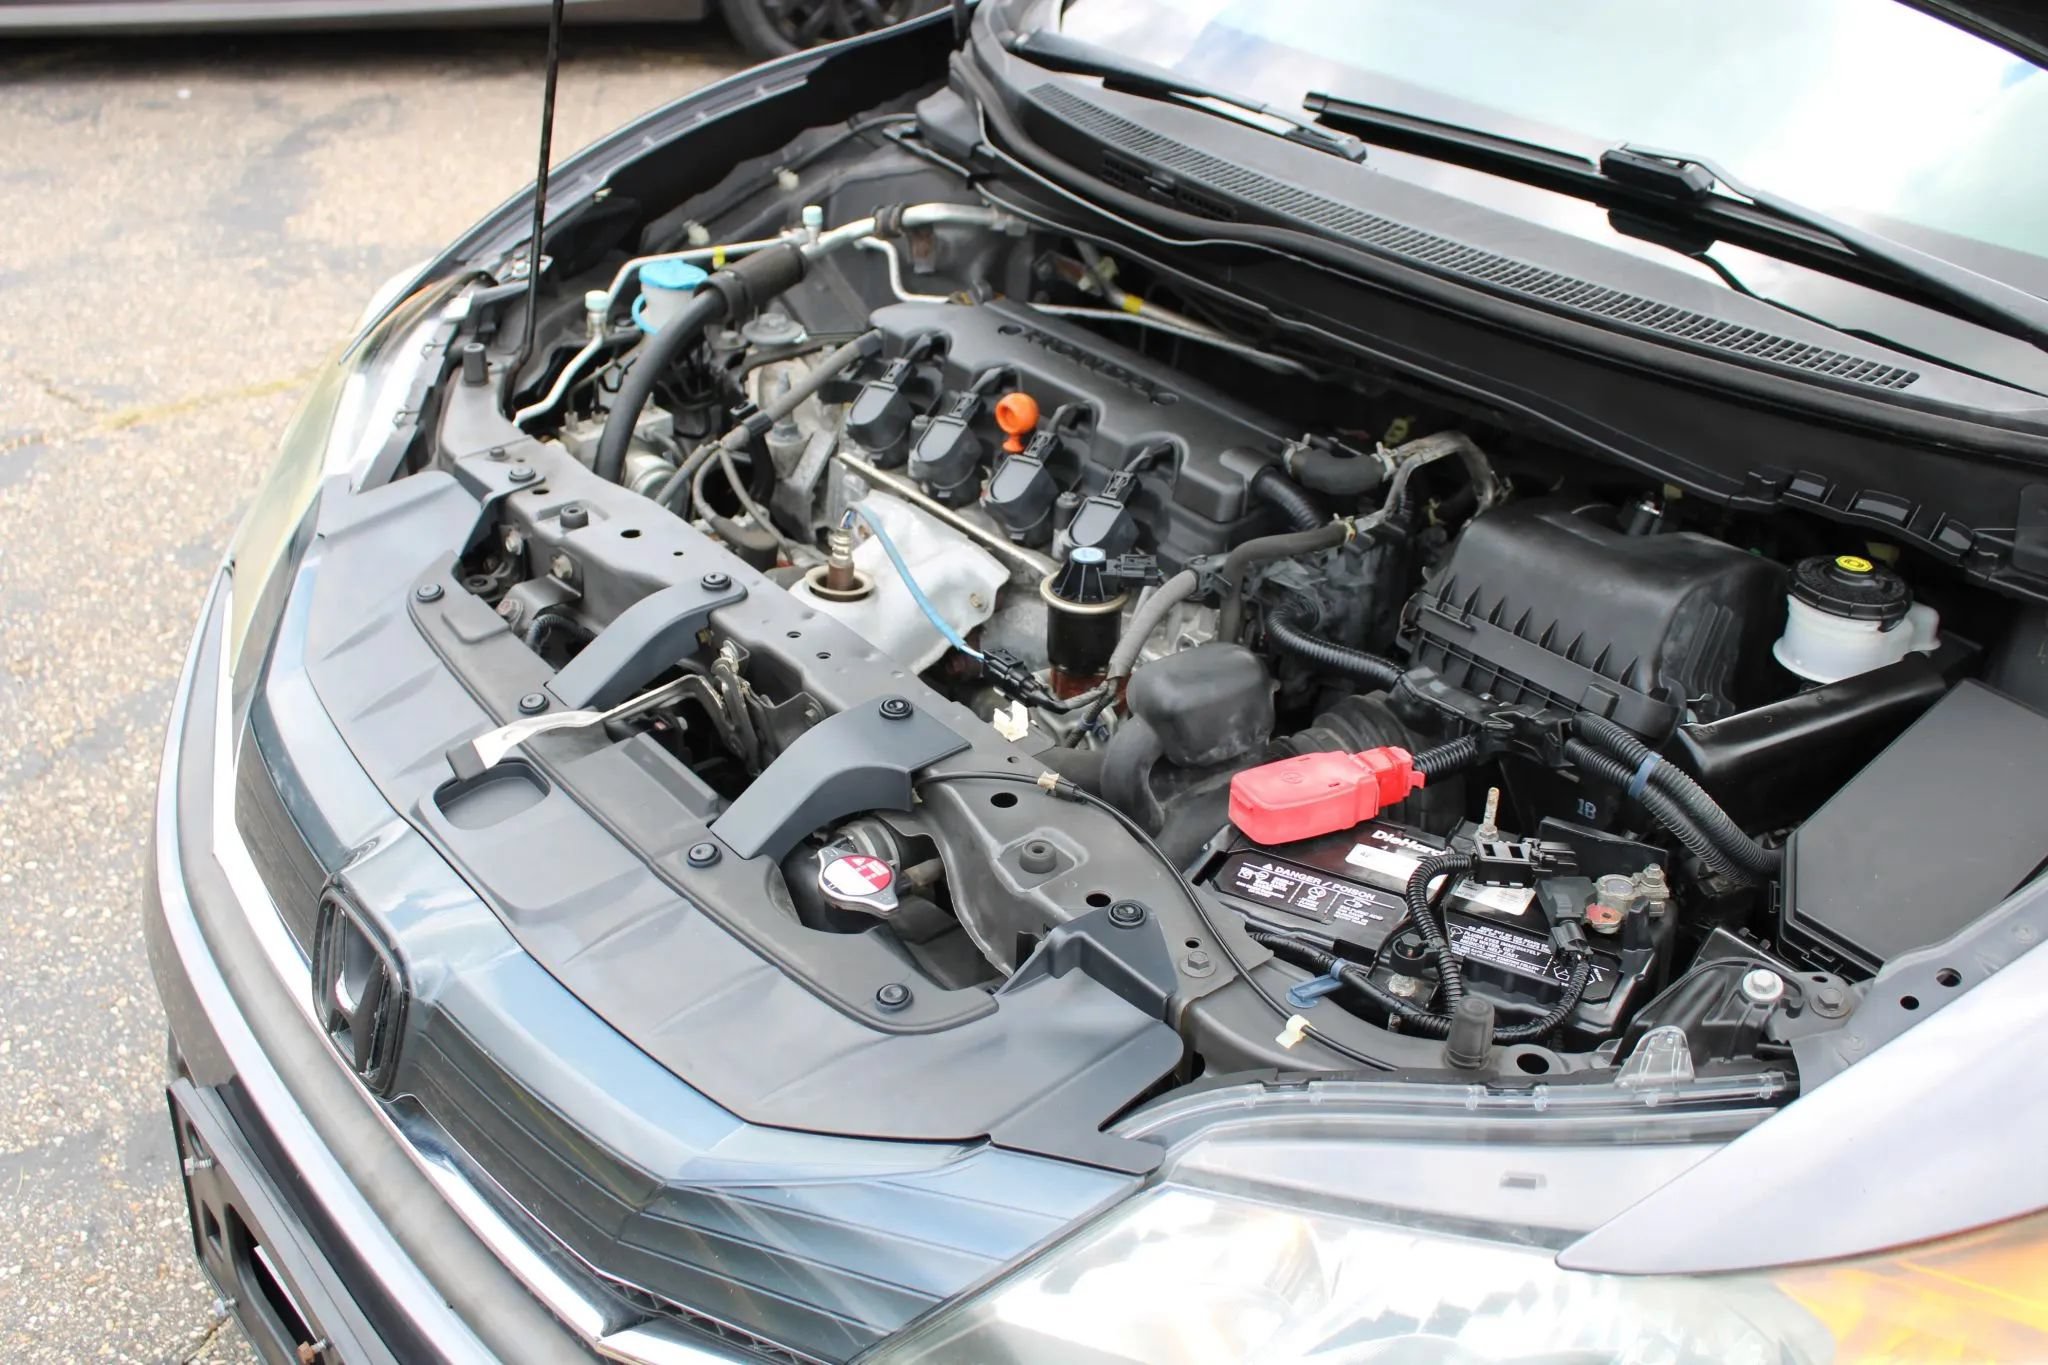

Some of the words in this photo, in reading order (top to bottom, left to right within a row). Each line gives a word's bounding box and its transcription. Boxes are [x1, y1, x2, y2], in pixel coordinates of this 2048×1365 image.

[1274, 866, 1322, 885] DANGER
[1332, 883, 1377, 901] POISON
[1463, 930, 1483, 940] FLUSH
[1500, 941, 1542, 957] IMMEDIATELY
[1486, 946, 1502, 954] HELP
[1503, 951, 1520, 959] FAST
